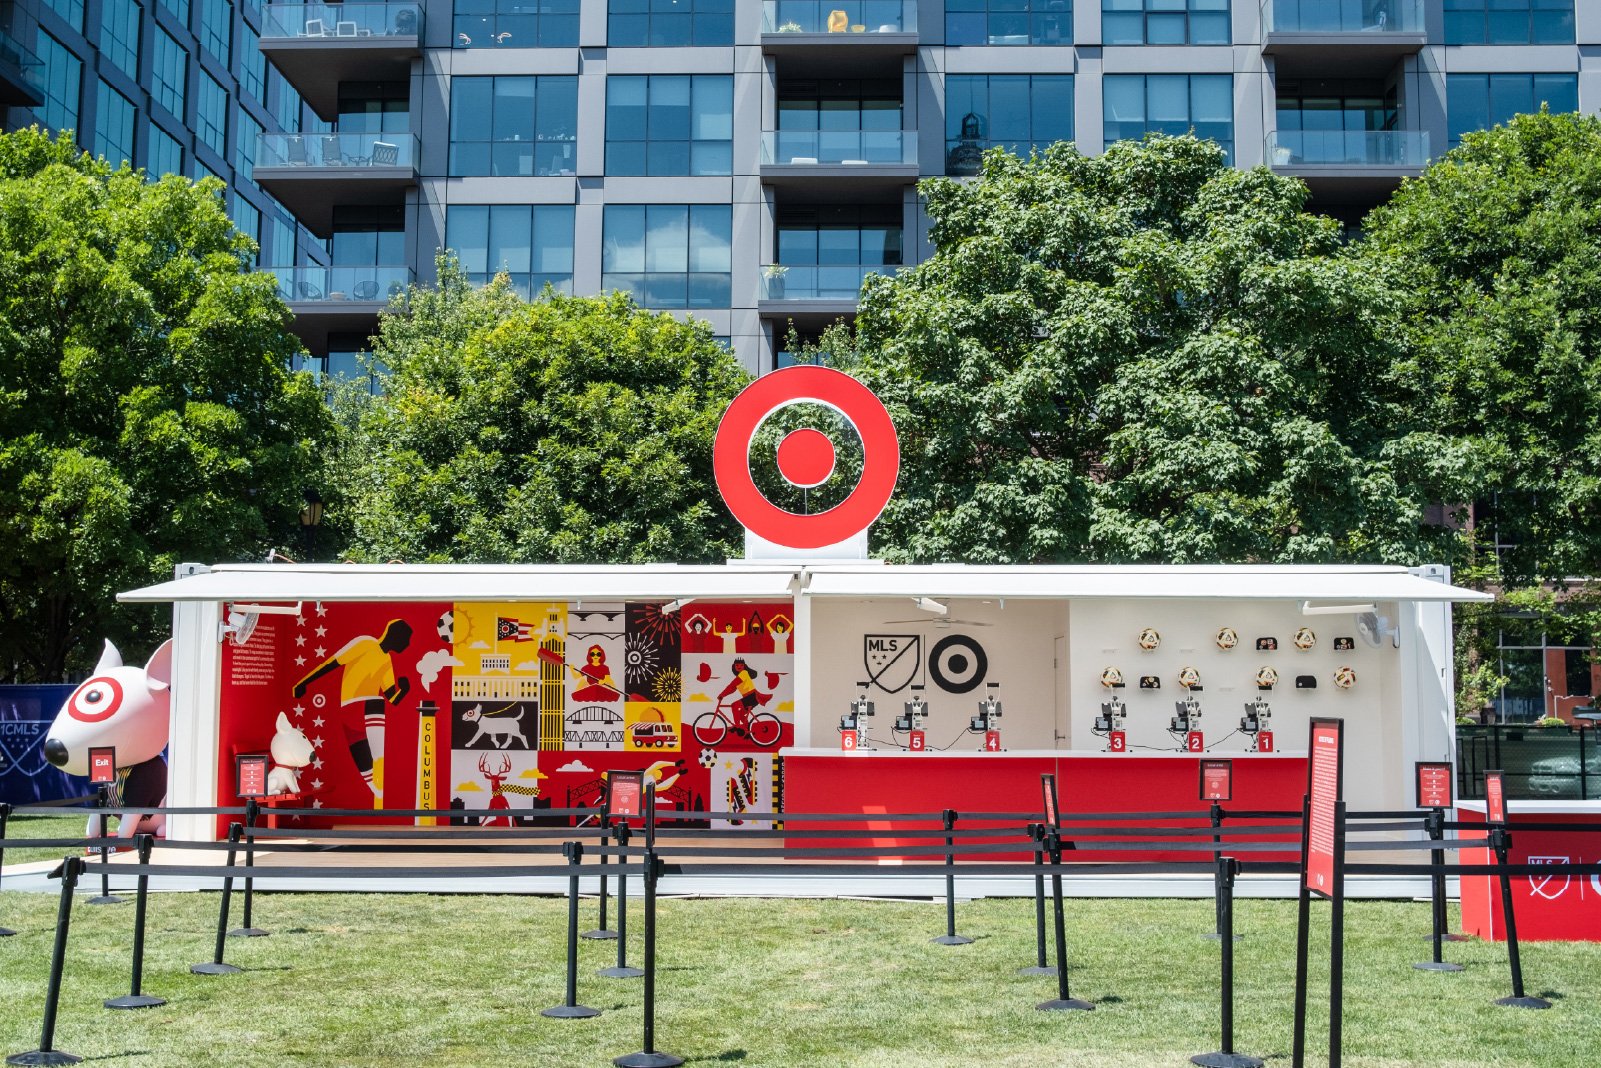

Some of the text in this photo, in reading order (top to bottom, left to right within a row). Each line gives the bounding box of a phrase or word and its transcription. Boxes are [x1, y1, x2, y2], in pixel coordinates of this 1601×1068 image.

[868, 640, 897, 651] MLS
[845, 737, 852, 748] 6
[912, 737, 921, 749] 5
[989, 738, 997, 749] 4
[1113, 738, 1122, 749] 3
[1191, 738, 1200, 749] 2
[1262, 738, 1269, 749] 1
[95, 759, 108, 767] Exit
[423, 722, 431, 811] COLUMBUS
